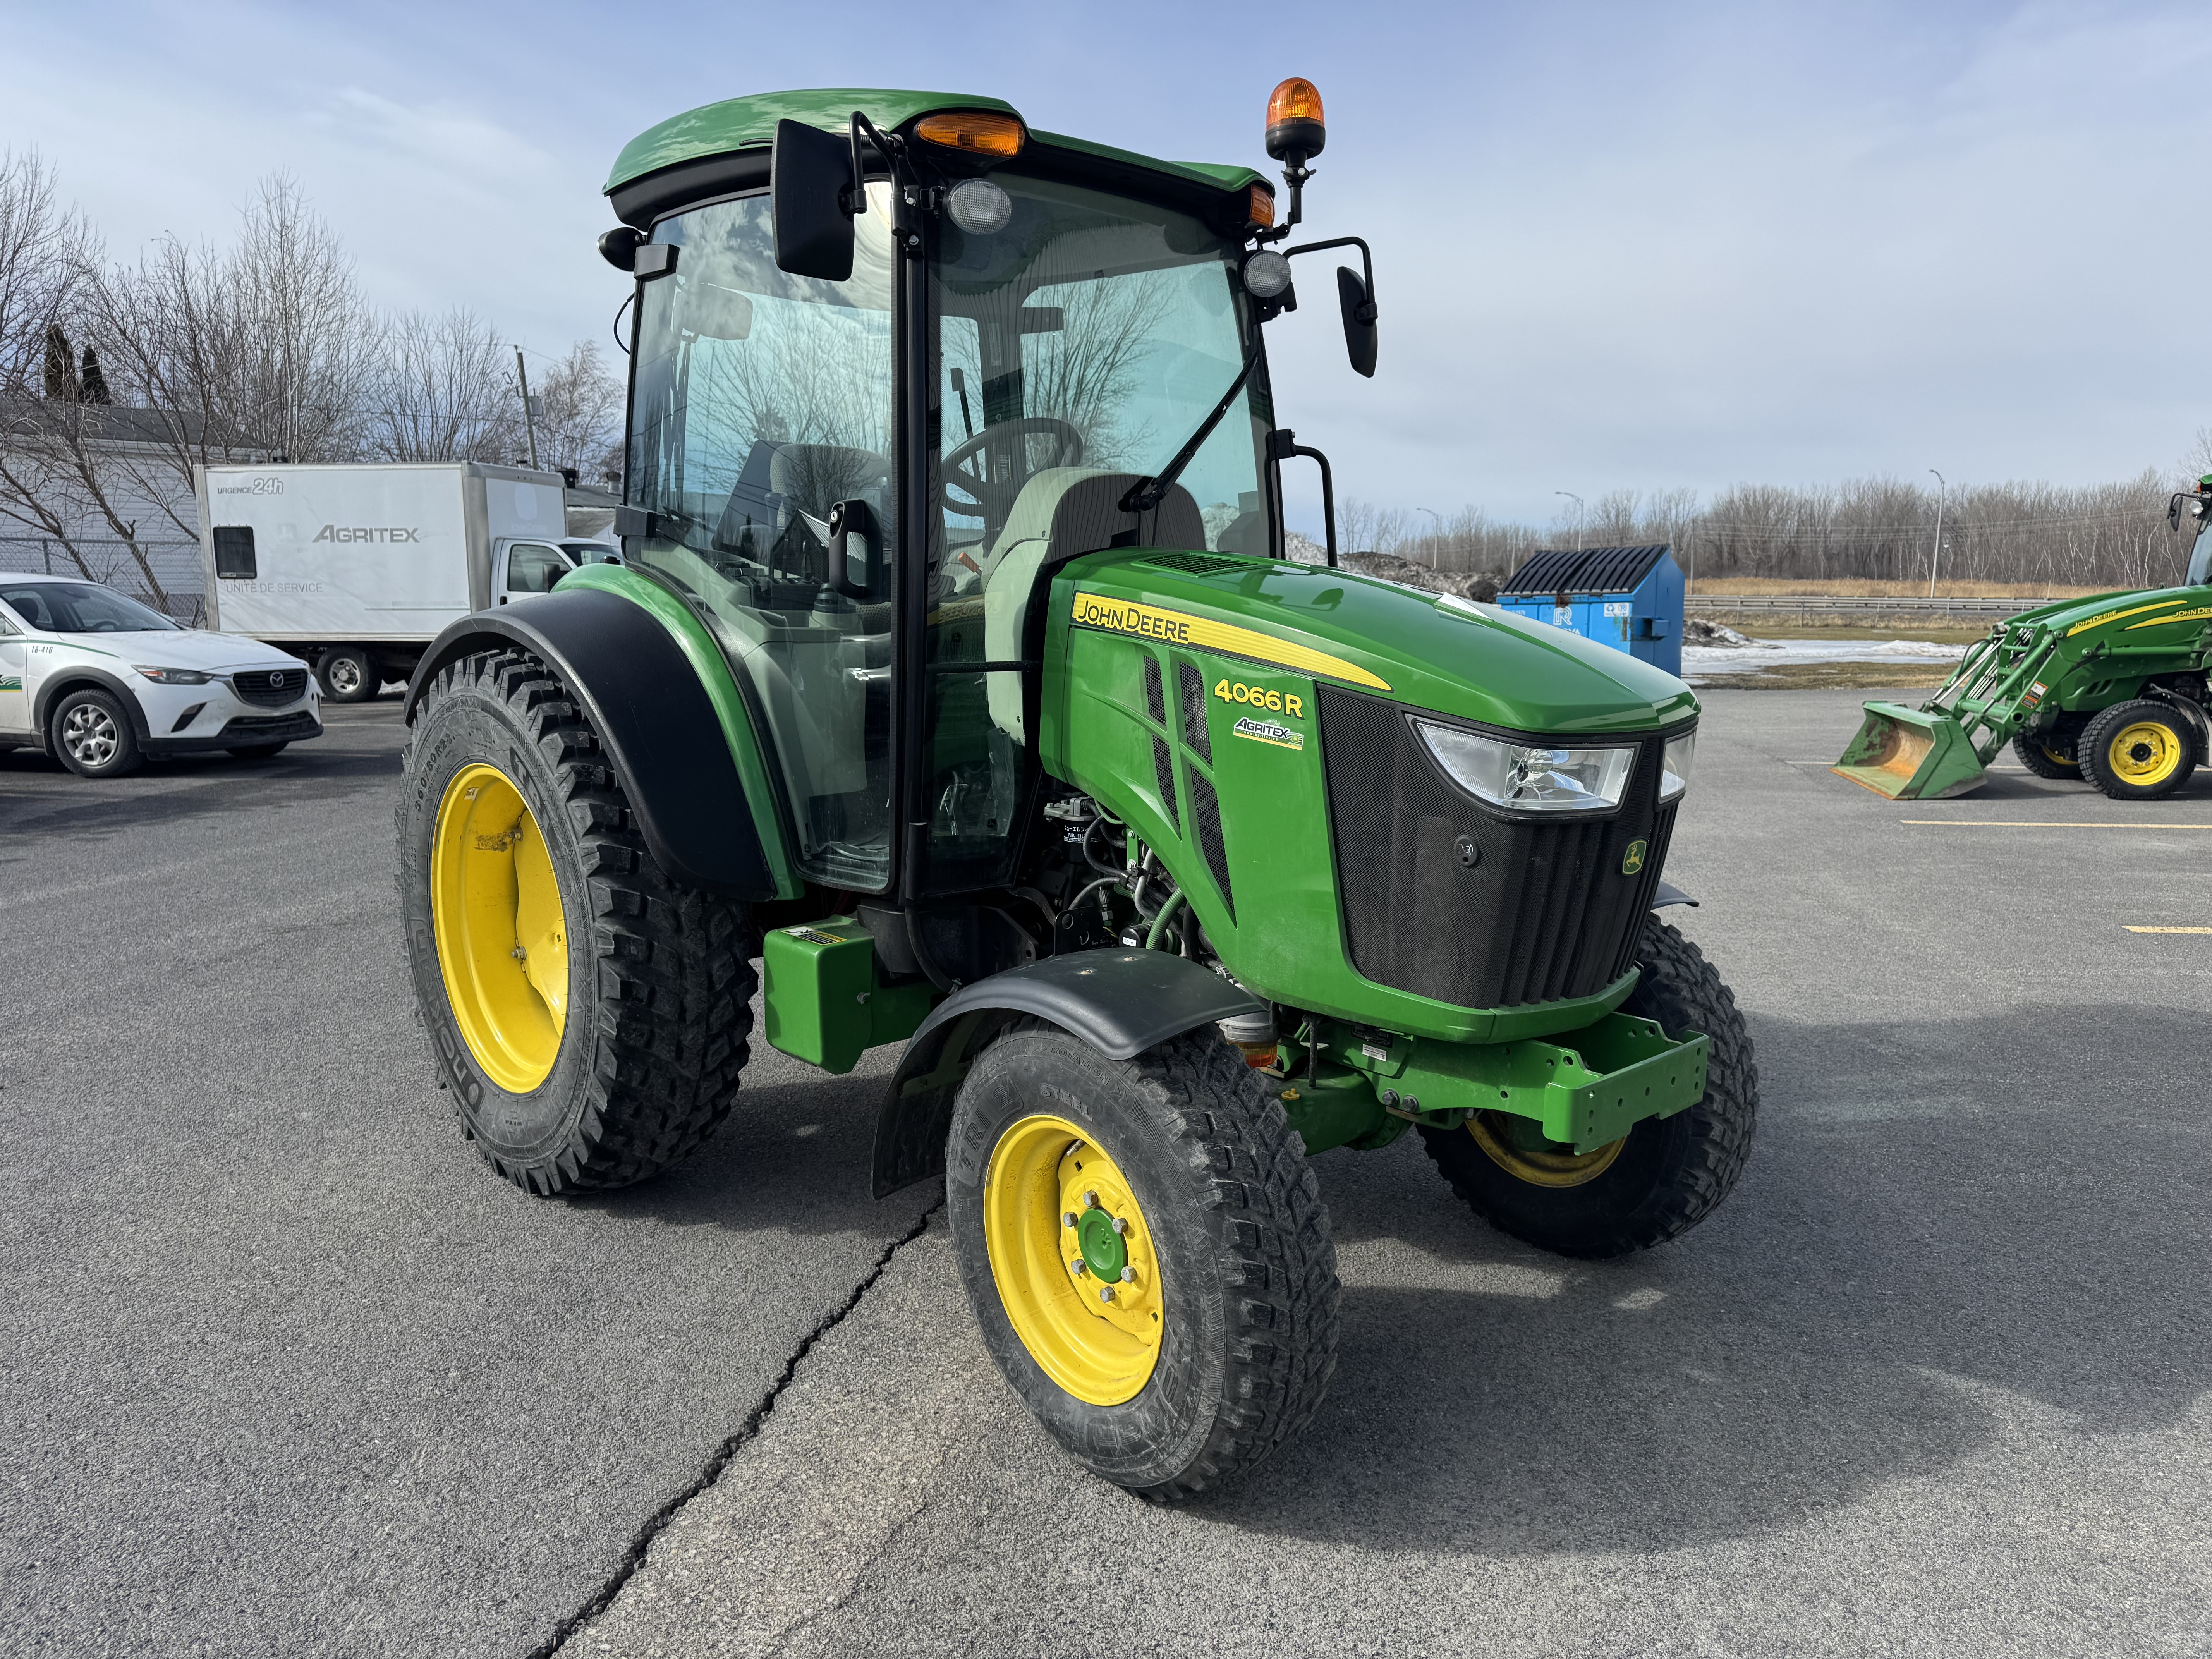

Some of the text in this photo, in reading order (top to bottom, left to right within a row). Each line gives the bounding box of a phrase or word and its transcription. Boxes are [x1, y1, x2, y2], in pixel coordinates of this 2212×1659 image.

[252, 477, 283, 495] 24h
[312, 524, 420, 543] AGRITEX
[260, 582, 274, 592] DE
[277, 582, 323, 593] SERVICE
[1078, 600, 1190, 641] JOHN DEERE
[2073, 610, 2118, 629] JOHN DEERE
[2172, 608, 2197, 618] JOHN
[31, 646, 53, 654] 18-416
[1235, 718, 1288, 738] AGRITEX
[1050, 1045, 1111, 1086] ROTATION
[1039, 1082, 1093, 1121] STEEL
[959, 1085, 1012, 1171] TRI 2
